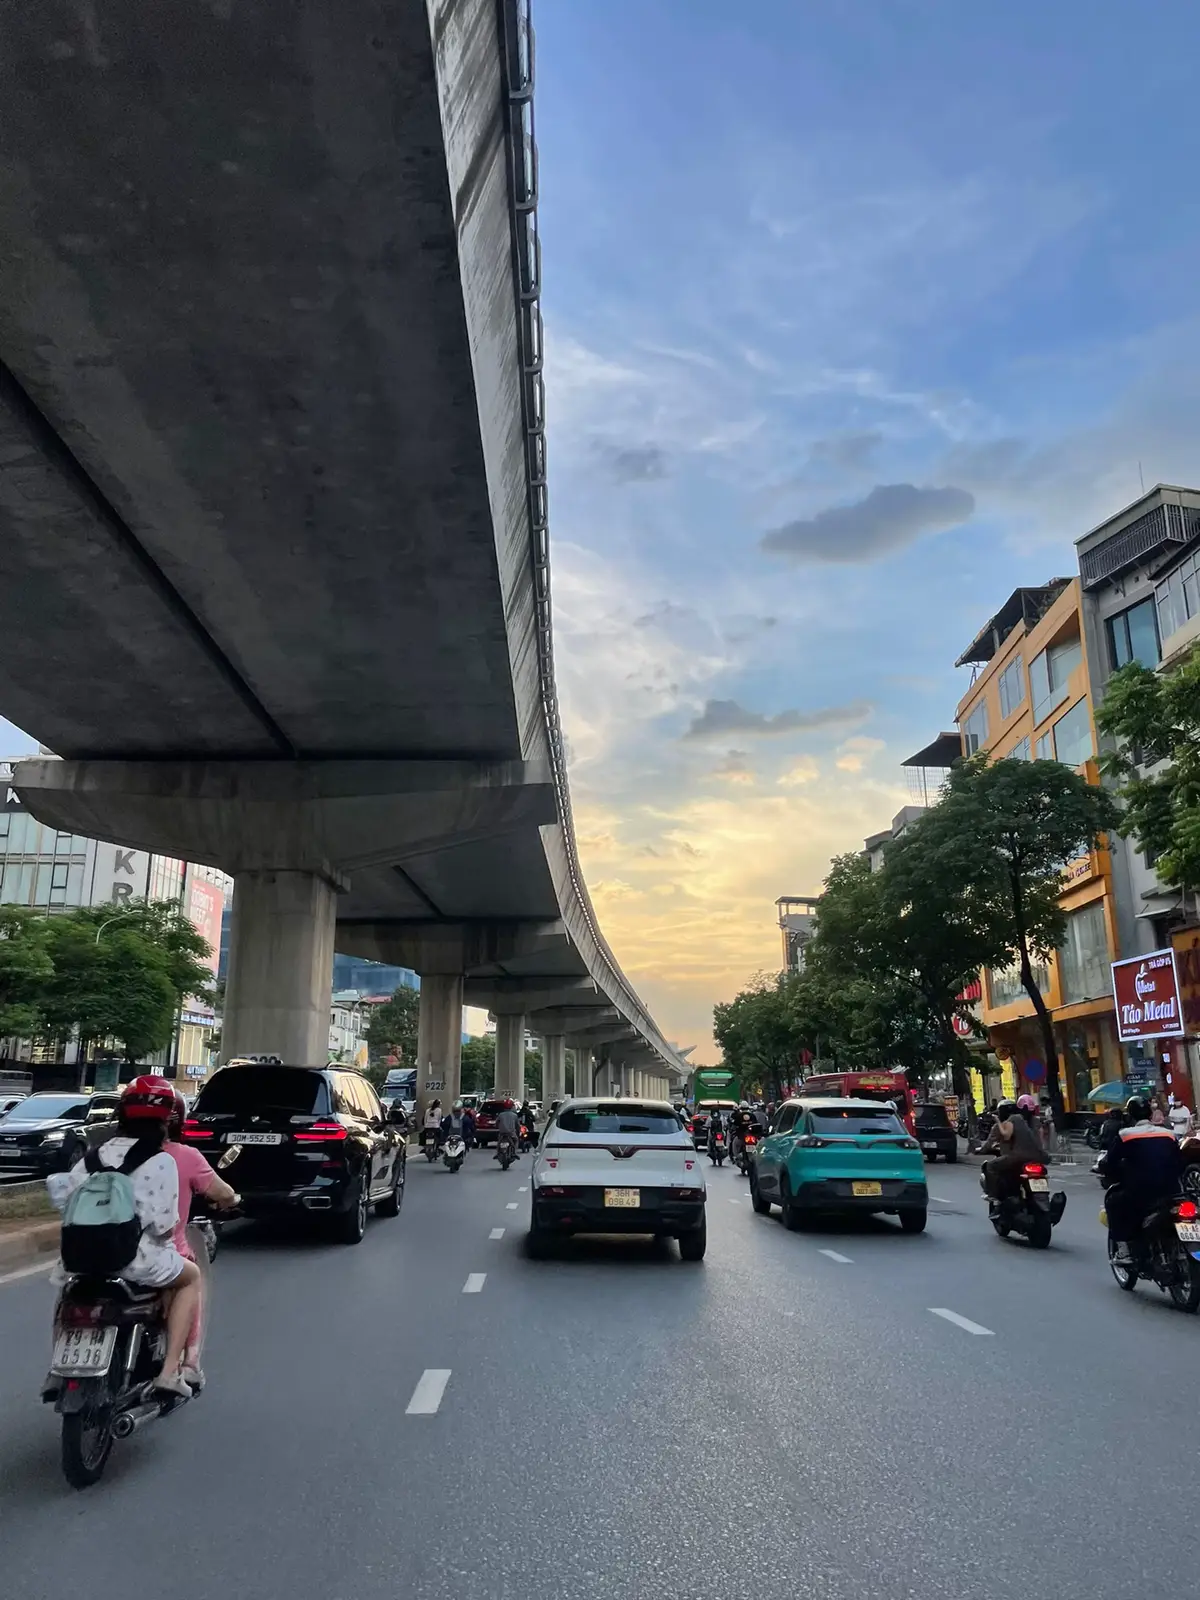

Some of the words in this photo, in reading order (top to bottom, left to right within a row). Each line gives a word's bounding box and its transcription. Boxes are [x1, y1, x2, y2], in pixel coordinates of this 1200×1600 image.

[1137, 980, 1155, 993] Metal
[1122, 1004, 1141, 1024] Táo
[1144, 996, 1176, 1021] Metal
